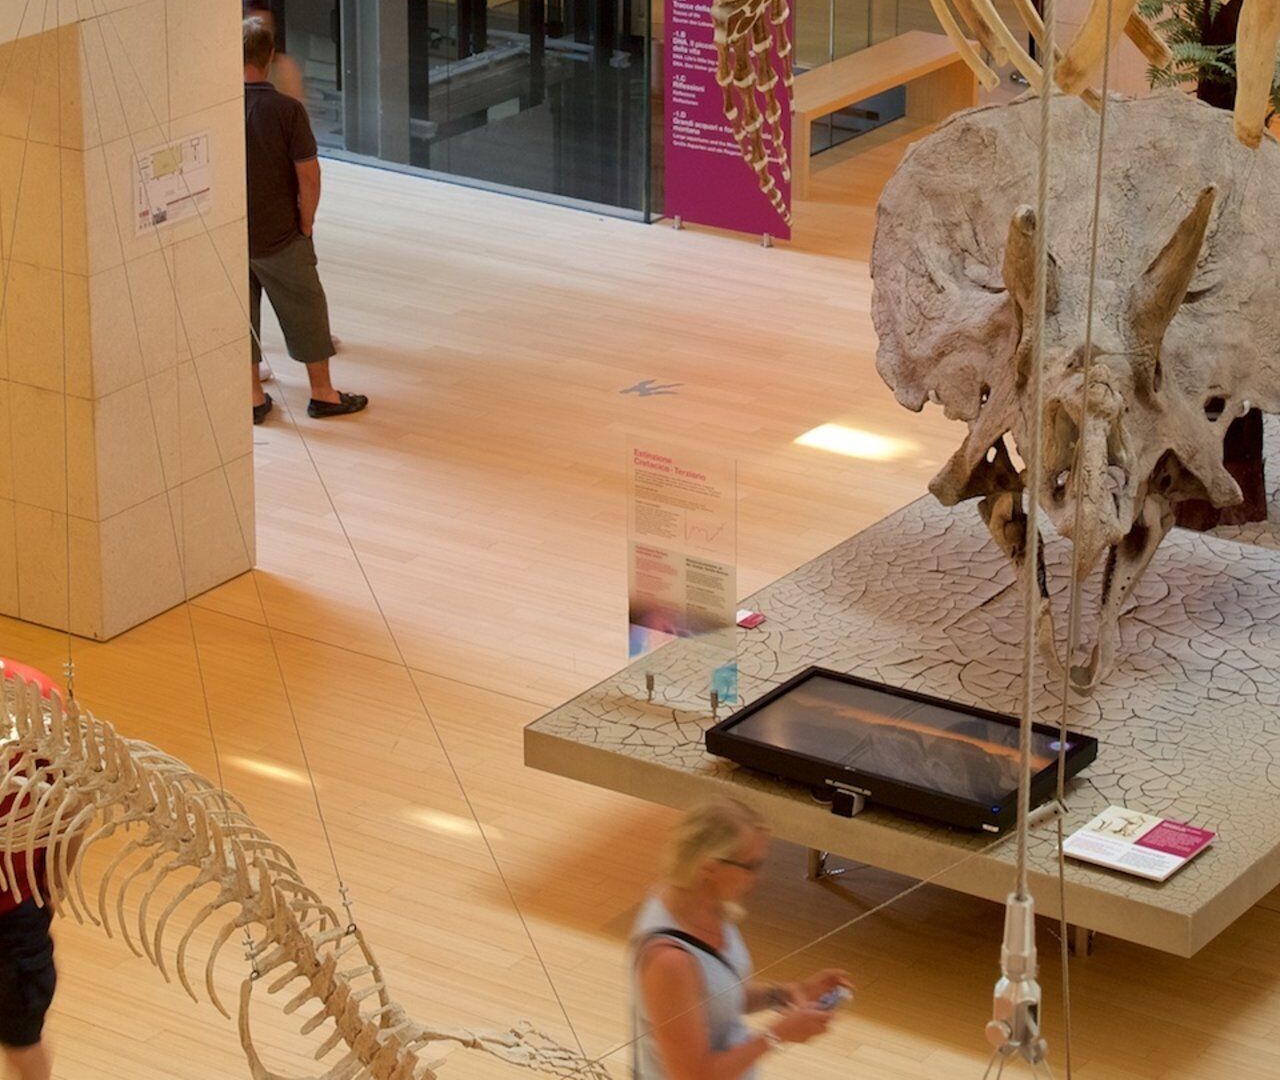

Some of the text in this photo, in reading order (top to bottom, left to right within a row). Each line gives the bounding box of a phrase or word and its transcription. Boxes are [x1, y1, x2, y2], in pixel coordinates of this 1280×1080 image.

[673, 1, 694, 11] Tracce
[673, 82, 705, 92] Riflessioni
[673, 118, 694, 127] Grandi
